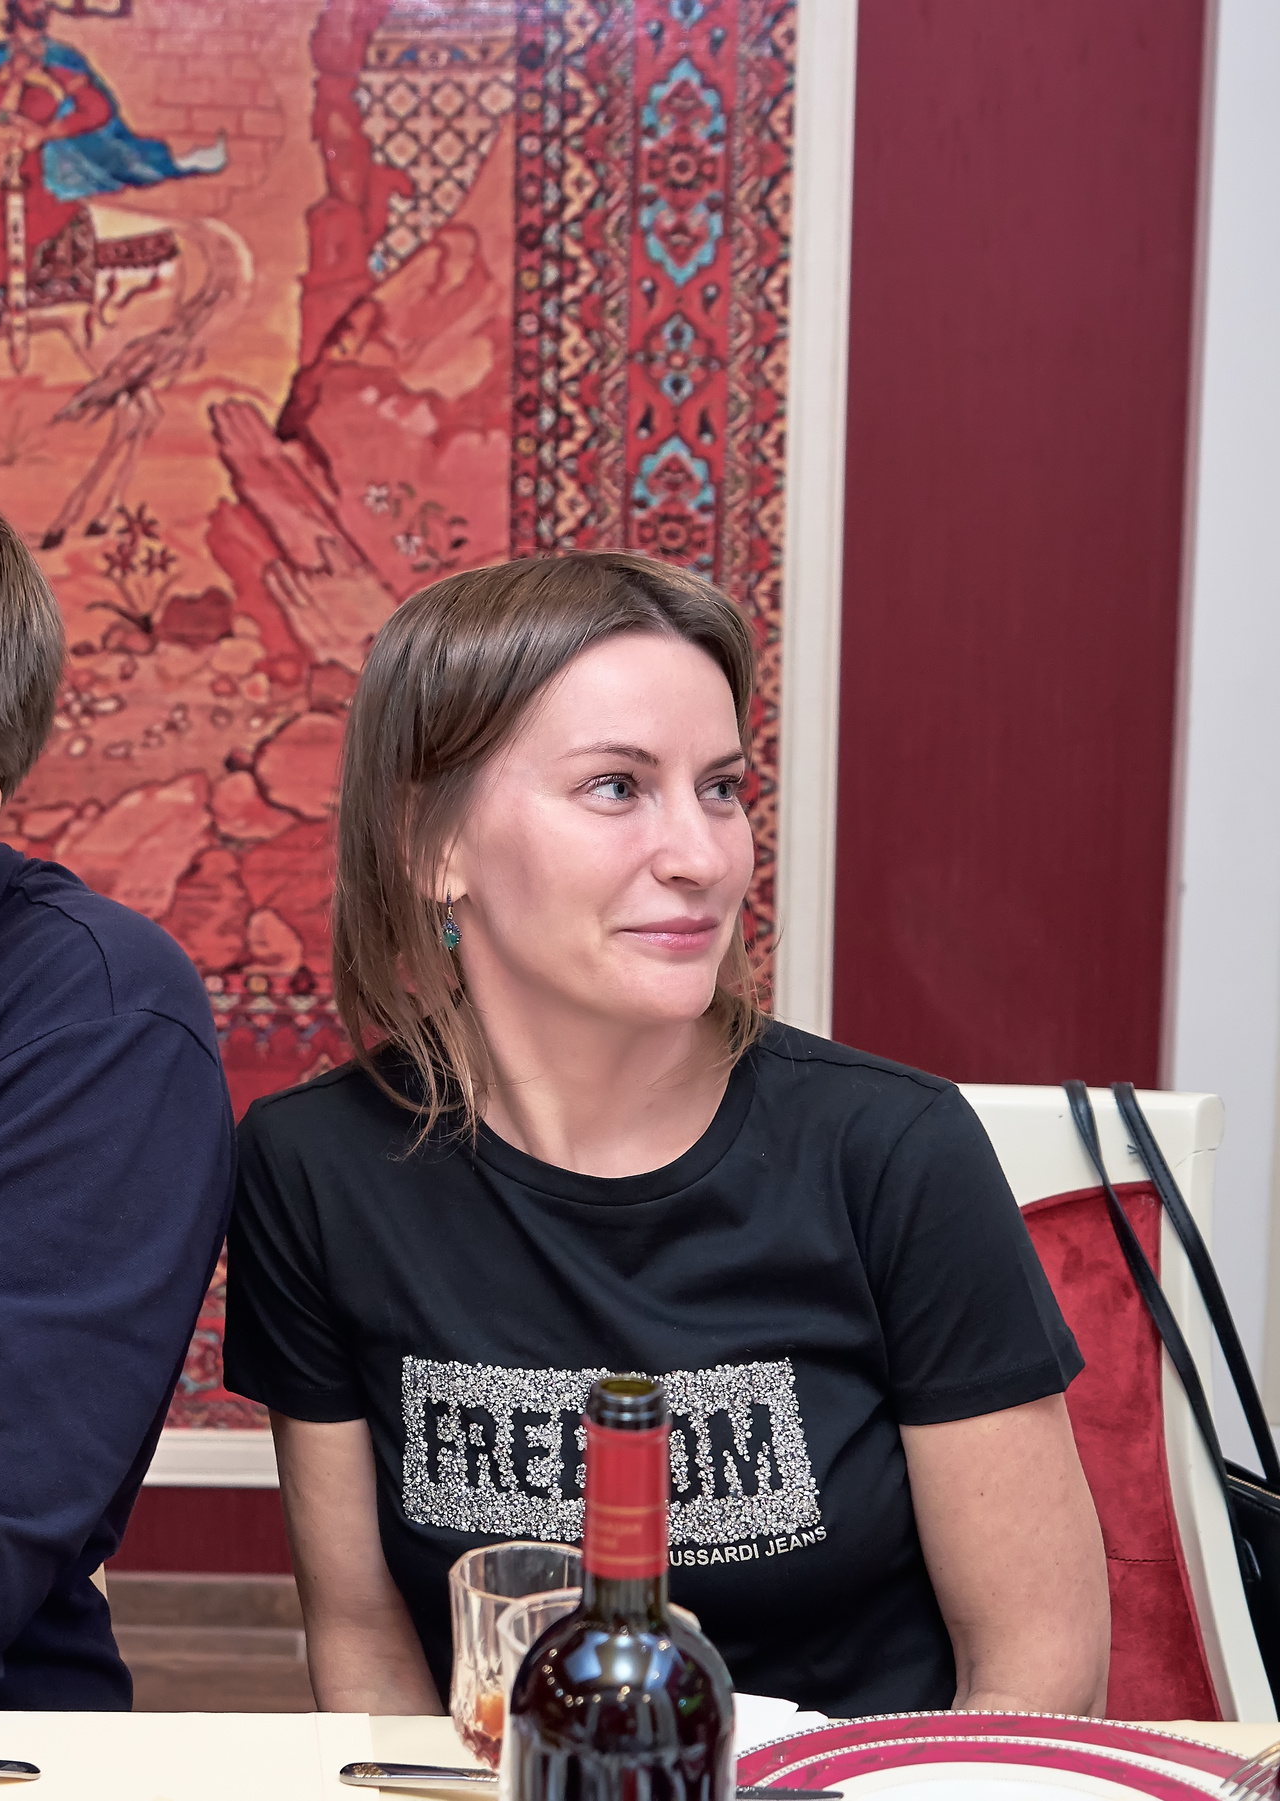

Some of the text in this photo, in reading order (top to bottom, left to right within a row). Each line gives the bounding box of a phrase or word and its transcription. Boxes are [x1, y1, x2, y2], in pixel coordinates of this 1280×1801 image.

[423, 1400, 784, 1500] FREEOM
[667, 1525, 827, 1567] USSARDI JEANS
